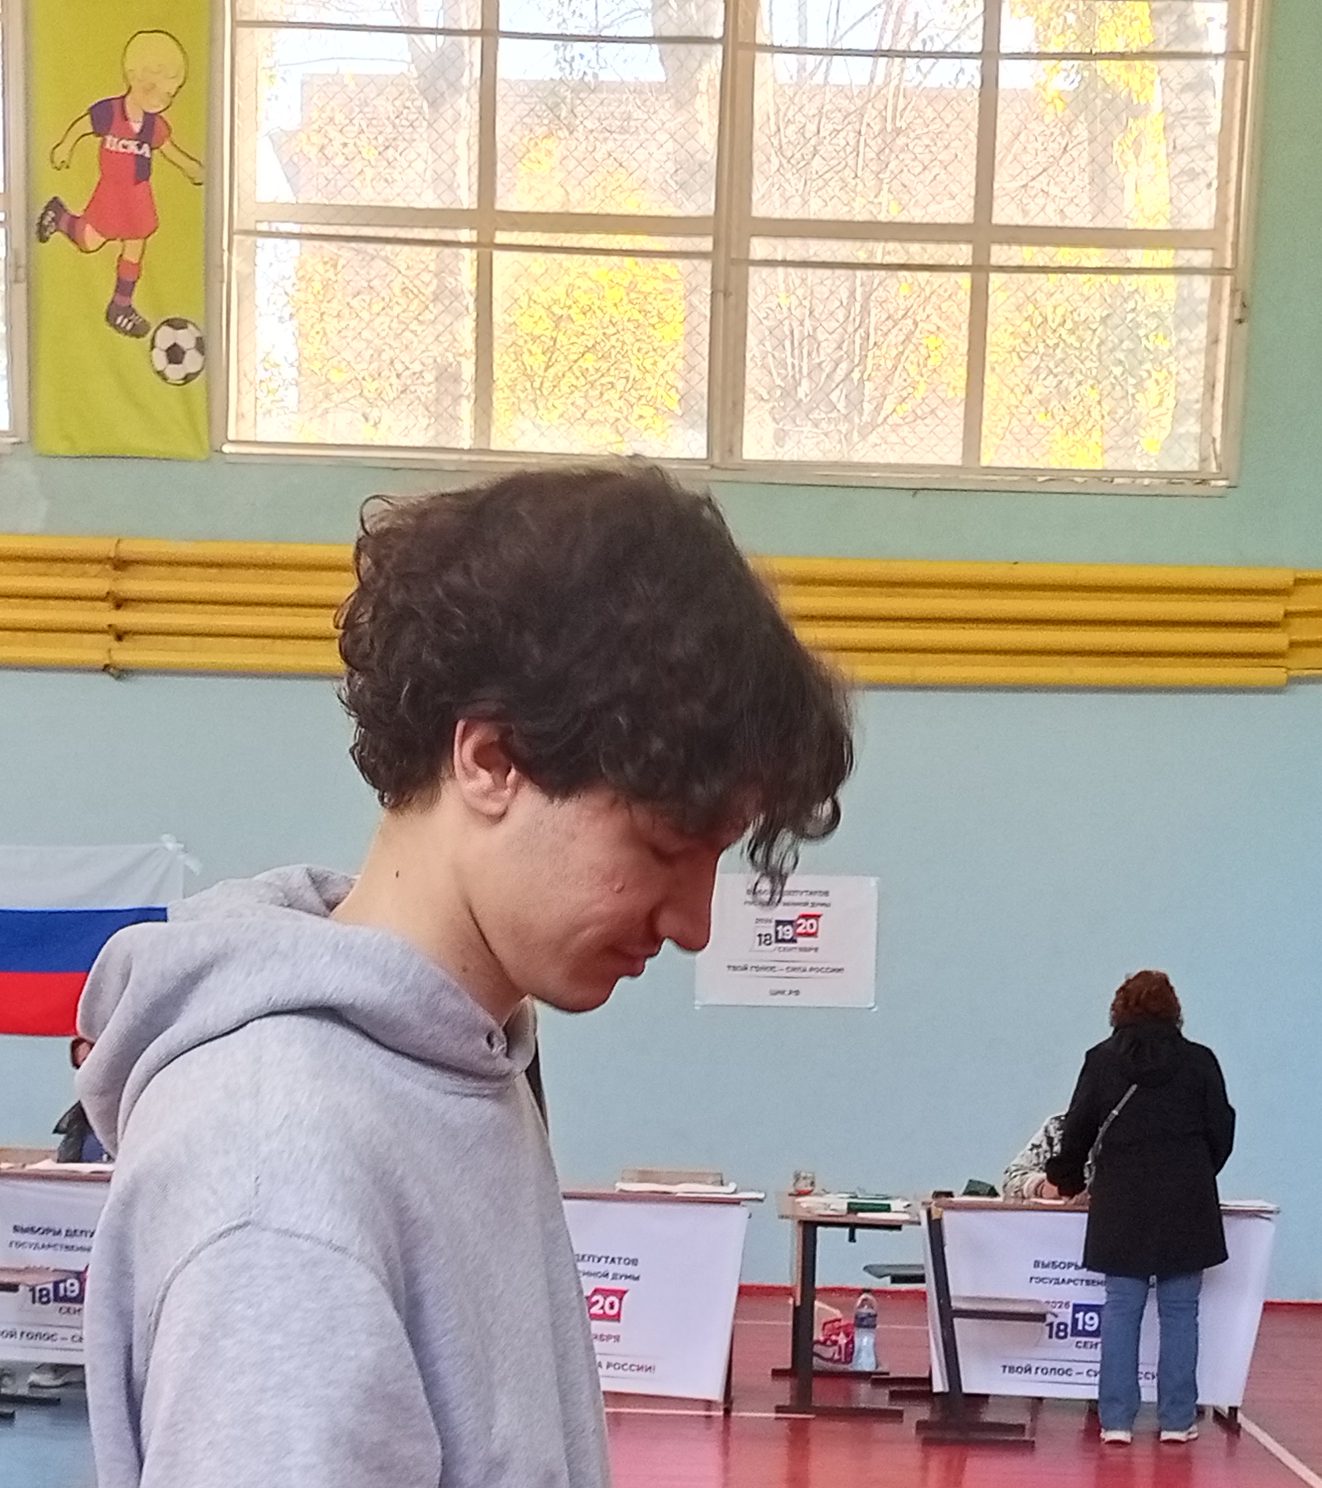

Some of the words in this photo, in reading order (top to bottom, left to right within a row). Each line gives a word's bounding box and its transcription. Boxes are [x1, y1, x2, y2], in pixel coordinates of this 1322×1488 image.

[757, 933, 773, 946] 18
[776, 925, 794, 940] 19
[795, 919, 817, 934] 20
[29, 1286, 52, 1306] 18
[59, 1279, 81, 1298] 19
[589, 1294, 620, 1316] 20
[1045, 1321, 1069, 1340] 18
[1075, 1312, 1100, 1331] 19
[1001, 1364, 1032, 1375] ТВОЙ
[1034, 1367, 1074, 1377] ГОЛОС
